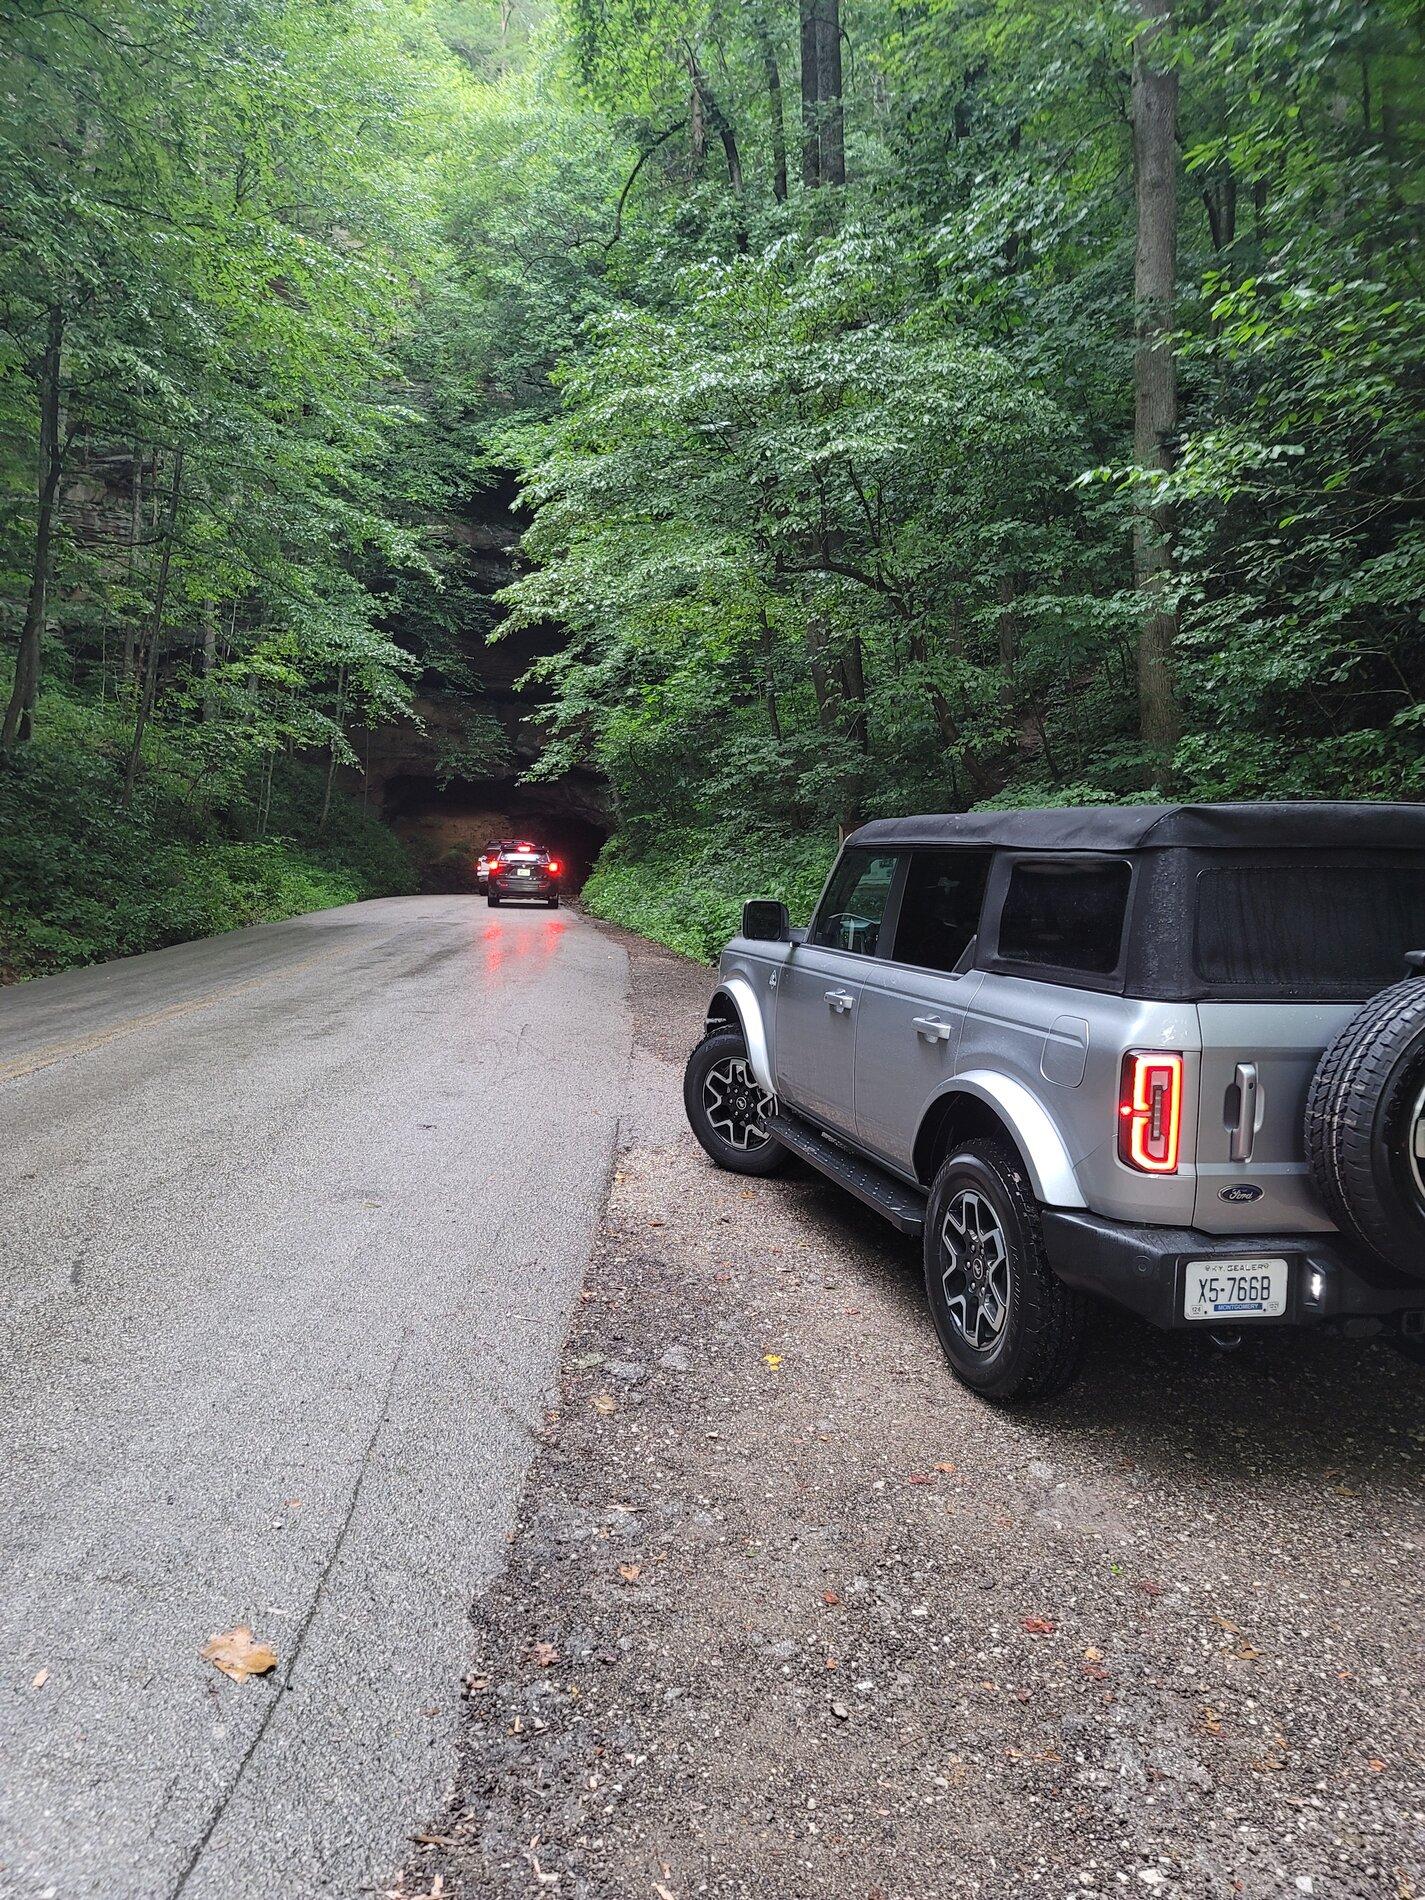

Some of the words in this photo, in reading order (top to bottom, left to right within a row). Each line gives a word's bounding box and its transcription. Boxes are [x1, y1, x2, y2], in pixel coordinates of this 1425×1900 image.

[1229, 1189, 1254, 1200] Ford
[1198, 1275, 1271, 1303] X5-766B
[1217, 1303, 1260, 1311] MONTGOMERY
